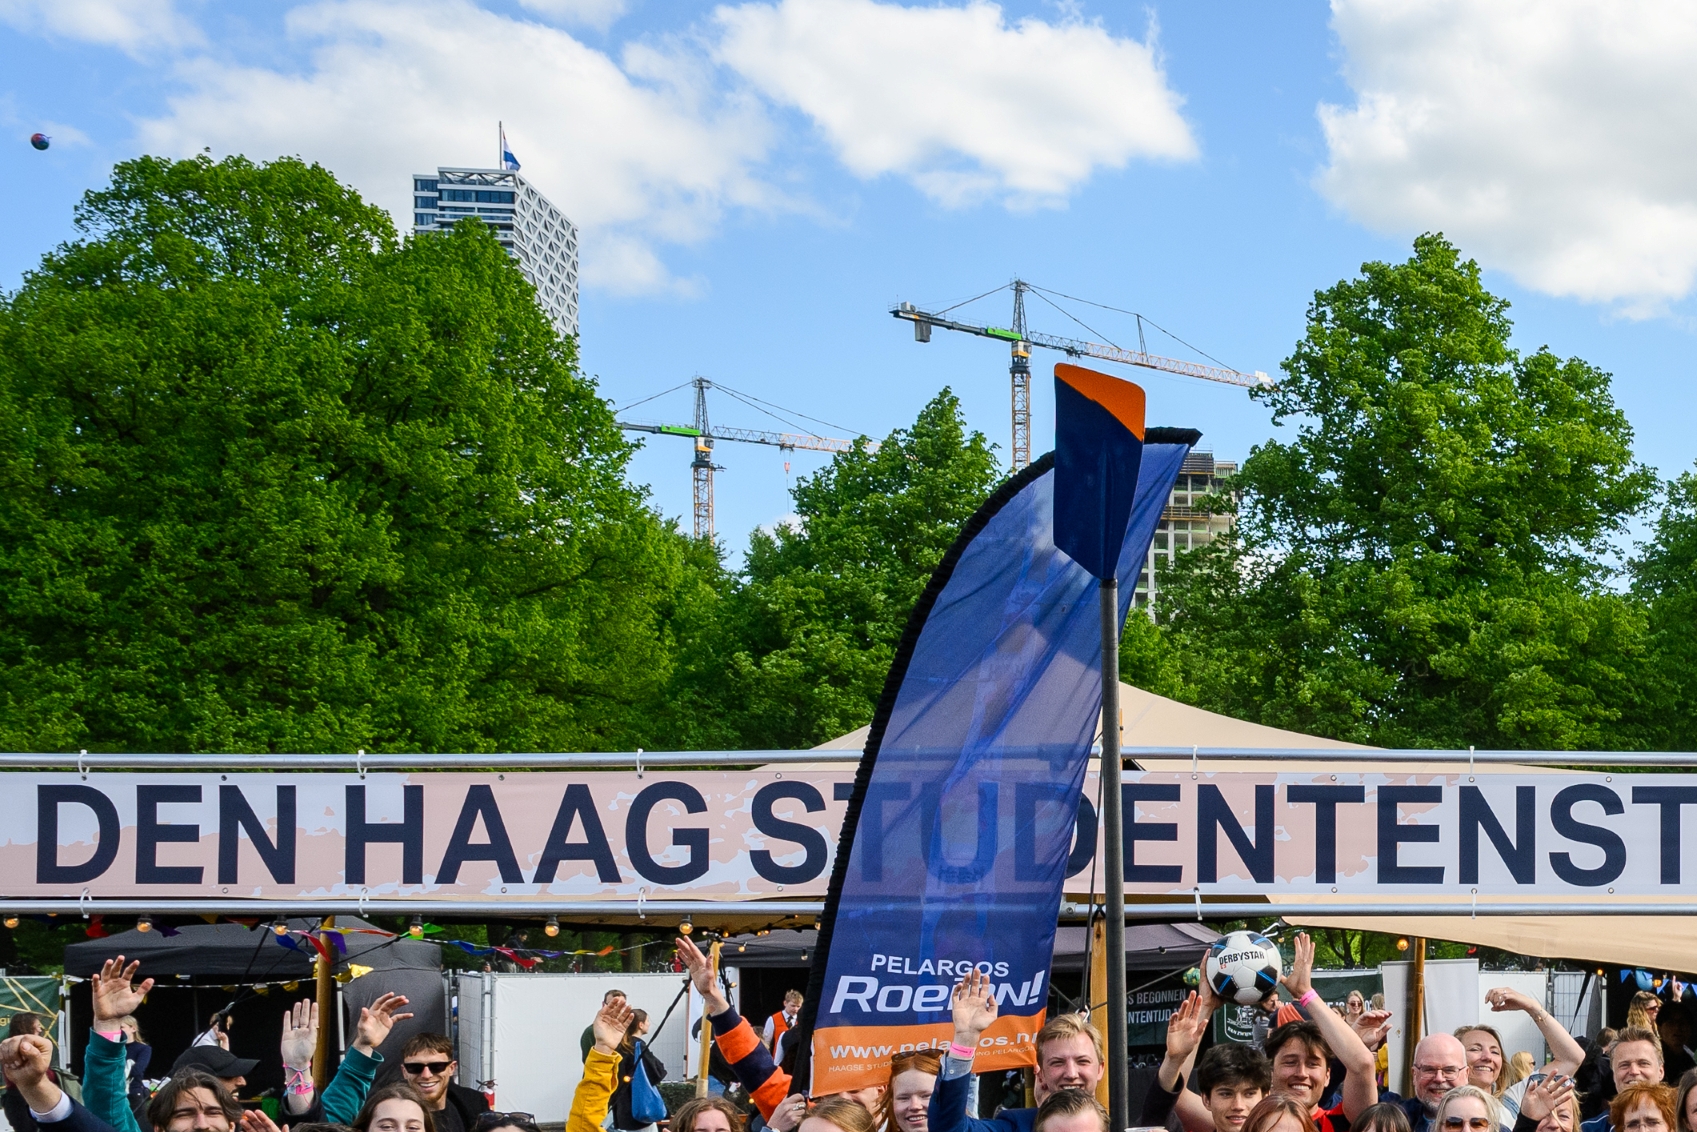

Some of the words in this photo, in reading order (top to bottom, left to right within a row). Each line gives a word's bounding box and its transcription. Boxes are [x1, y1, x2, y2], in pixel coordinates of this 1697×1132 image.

[37, 784, 297, 885] DEN
[345, 781, 710, 885] HAAG
[870, 953, 1010, 977] PELARGOS
[1219, 950, 1265, 965] DERBYSTAR
[1136, 988, 1187, 1005] BEGONNEN
[1127, 1009, 1171, 1024] NTENTIJD
